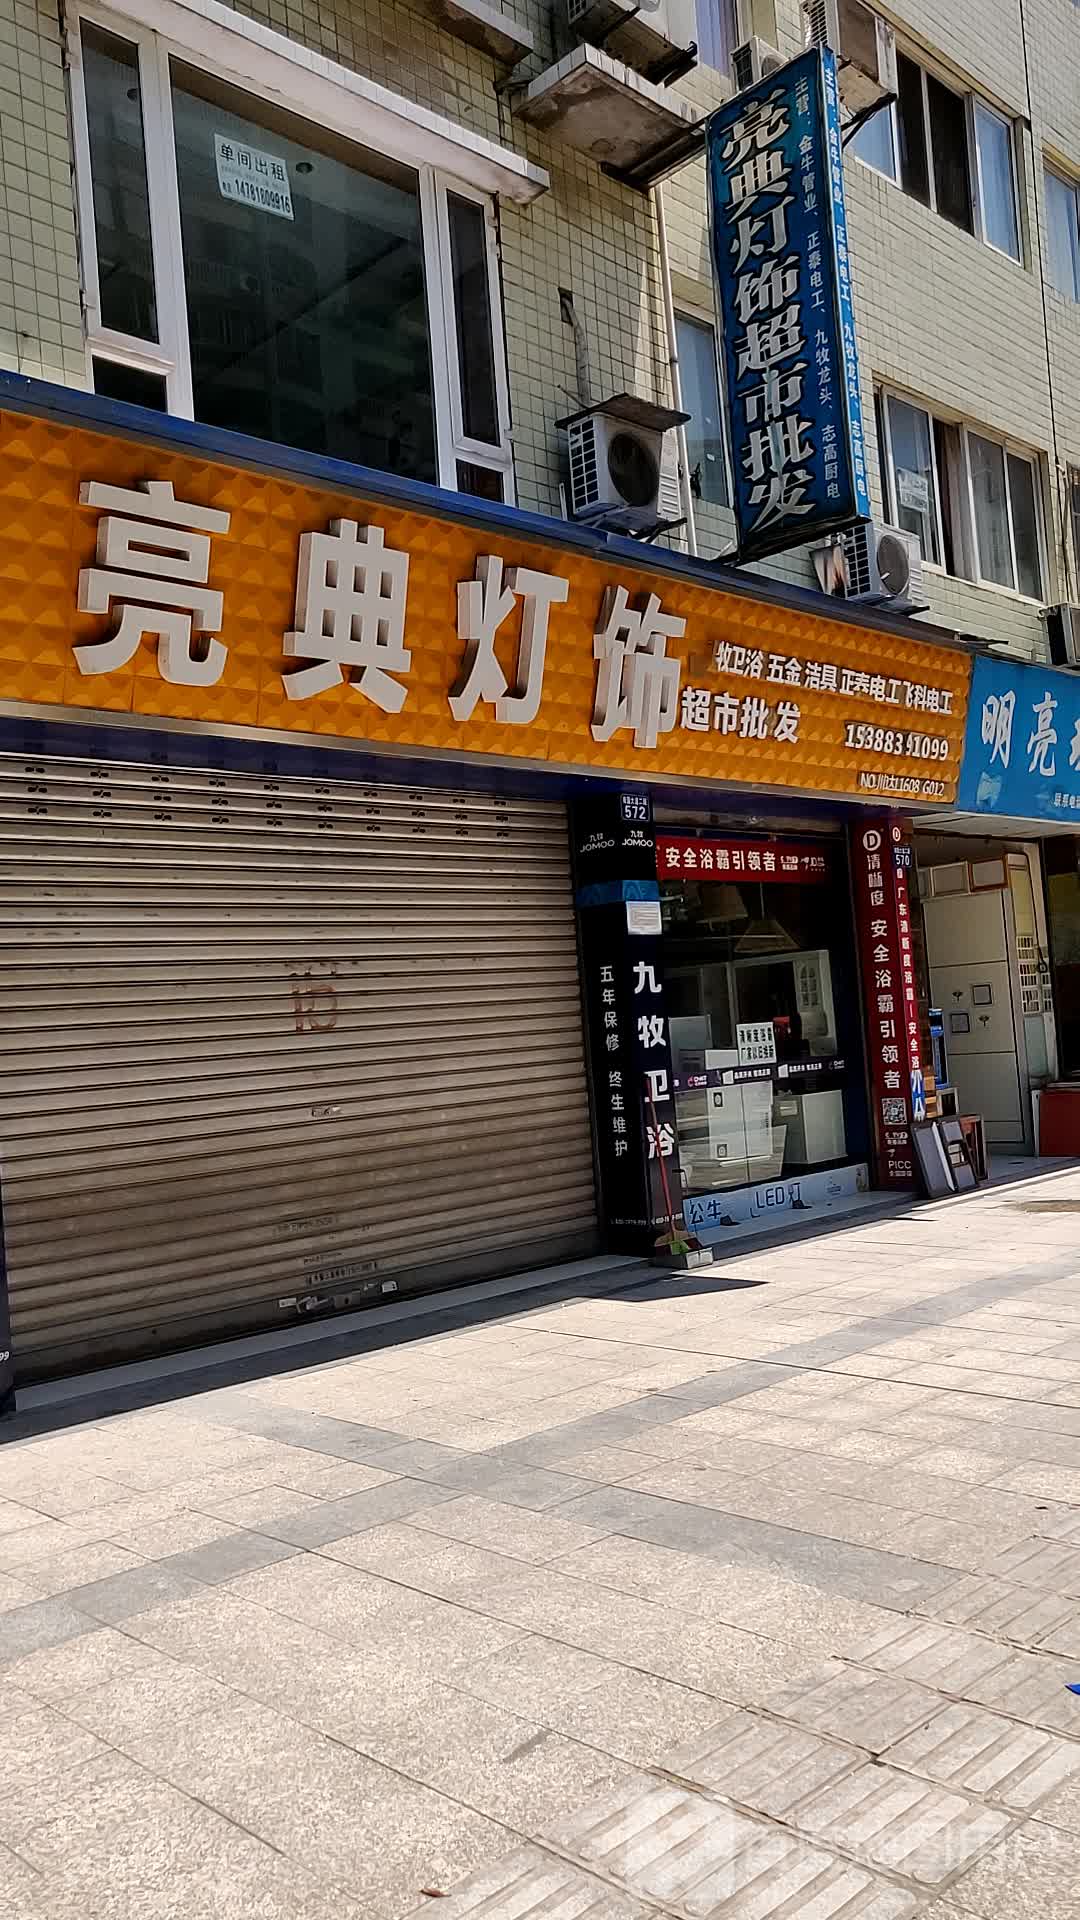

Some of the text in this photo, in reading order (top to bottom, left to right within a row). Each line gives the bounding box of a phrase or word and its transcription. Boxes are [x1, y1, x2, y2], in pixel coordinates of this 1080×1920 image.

[220, 144, 286, 182] 单间出租
[720, 88, 816, 534] 亮典灯饰超市批发
[73, 480, 688, 749] 亮典灯饰
[680, 686, 801, 744] 超市批发
[625, 805, 647, 819] 572
[580, 839, 615, 853] JOMOO
[622, 838, 654, 847] JOMOO
[665, 847, 776, 872] 安全浴霸引领者
[895, 854, 910, 866] 570
[632, 961, 675, 1160] 九牧卫浴
[888, 1160, 912, 1169] PICC
